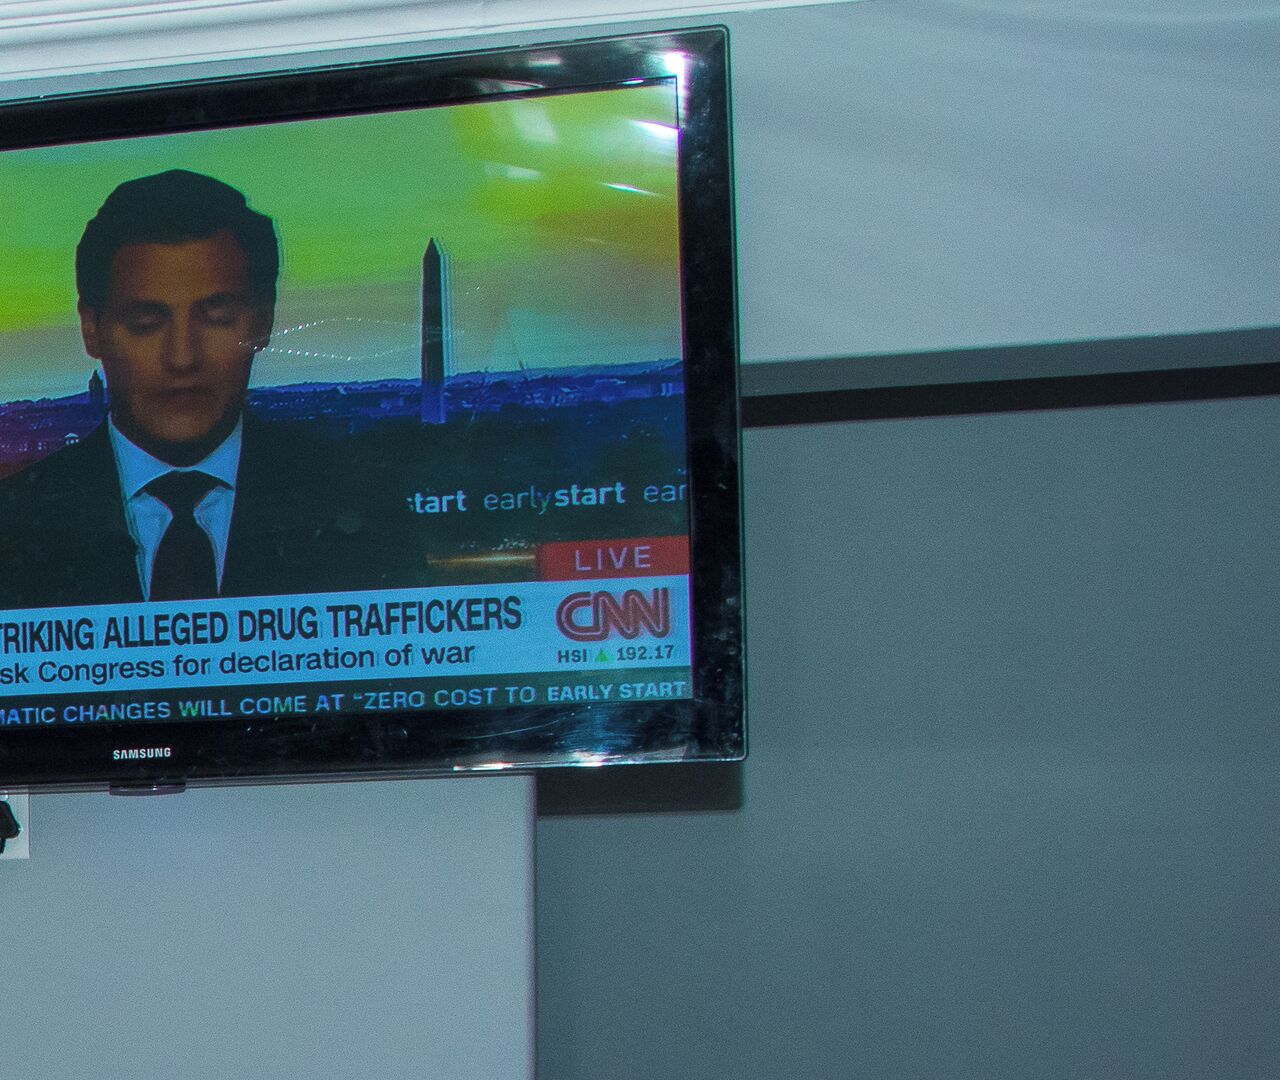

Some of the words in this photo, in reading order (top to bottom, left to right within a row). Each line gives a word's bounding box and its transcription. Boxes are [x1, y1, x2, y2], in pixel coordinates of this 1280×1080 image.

[575, 545, 652, 572] LIVE
[102, 610, 229, 649] ALLEGED
[238, 605, 319, 642] DRUG
[326, 595, 522, 638] TRAFFICKERS
[555, 587, 672, 642] CNN
[38, 659, 165, 686] Congress
[171, 654, 211, 677] for
[219, 646, 375, 674] declaration
[384, 643, 413, 667] of
[421, 643, 476, 665] war
[557, 649, 588, 664] HSI
[616, 644, 675, 661] 192.17
[63, 701, 172, 723] CHANGES
[179, 698, 233, 718] WILL
[240, 694, 308, 716] COME
[315, 692, 345, 712] AT
[434, 686, 498, 706] COST
[505, 685, 537, 704] TO
[547, 683, 614, 702] EARLY
[618, 680, 687, 700] START
[113, 747, 172, 761] SAMSUNG
